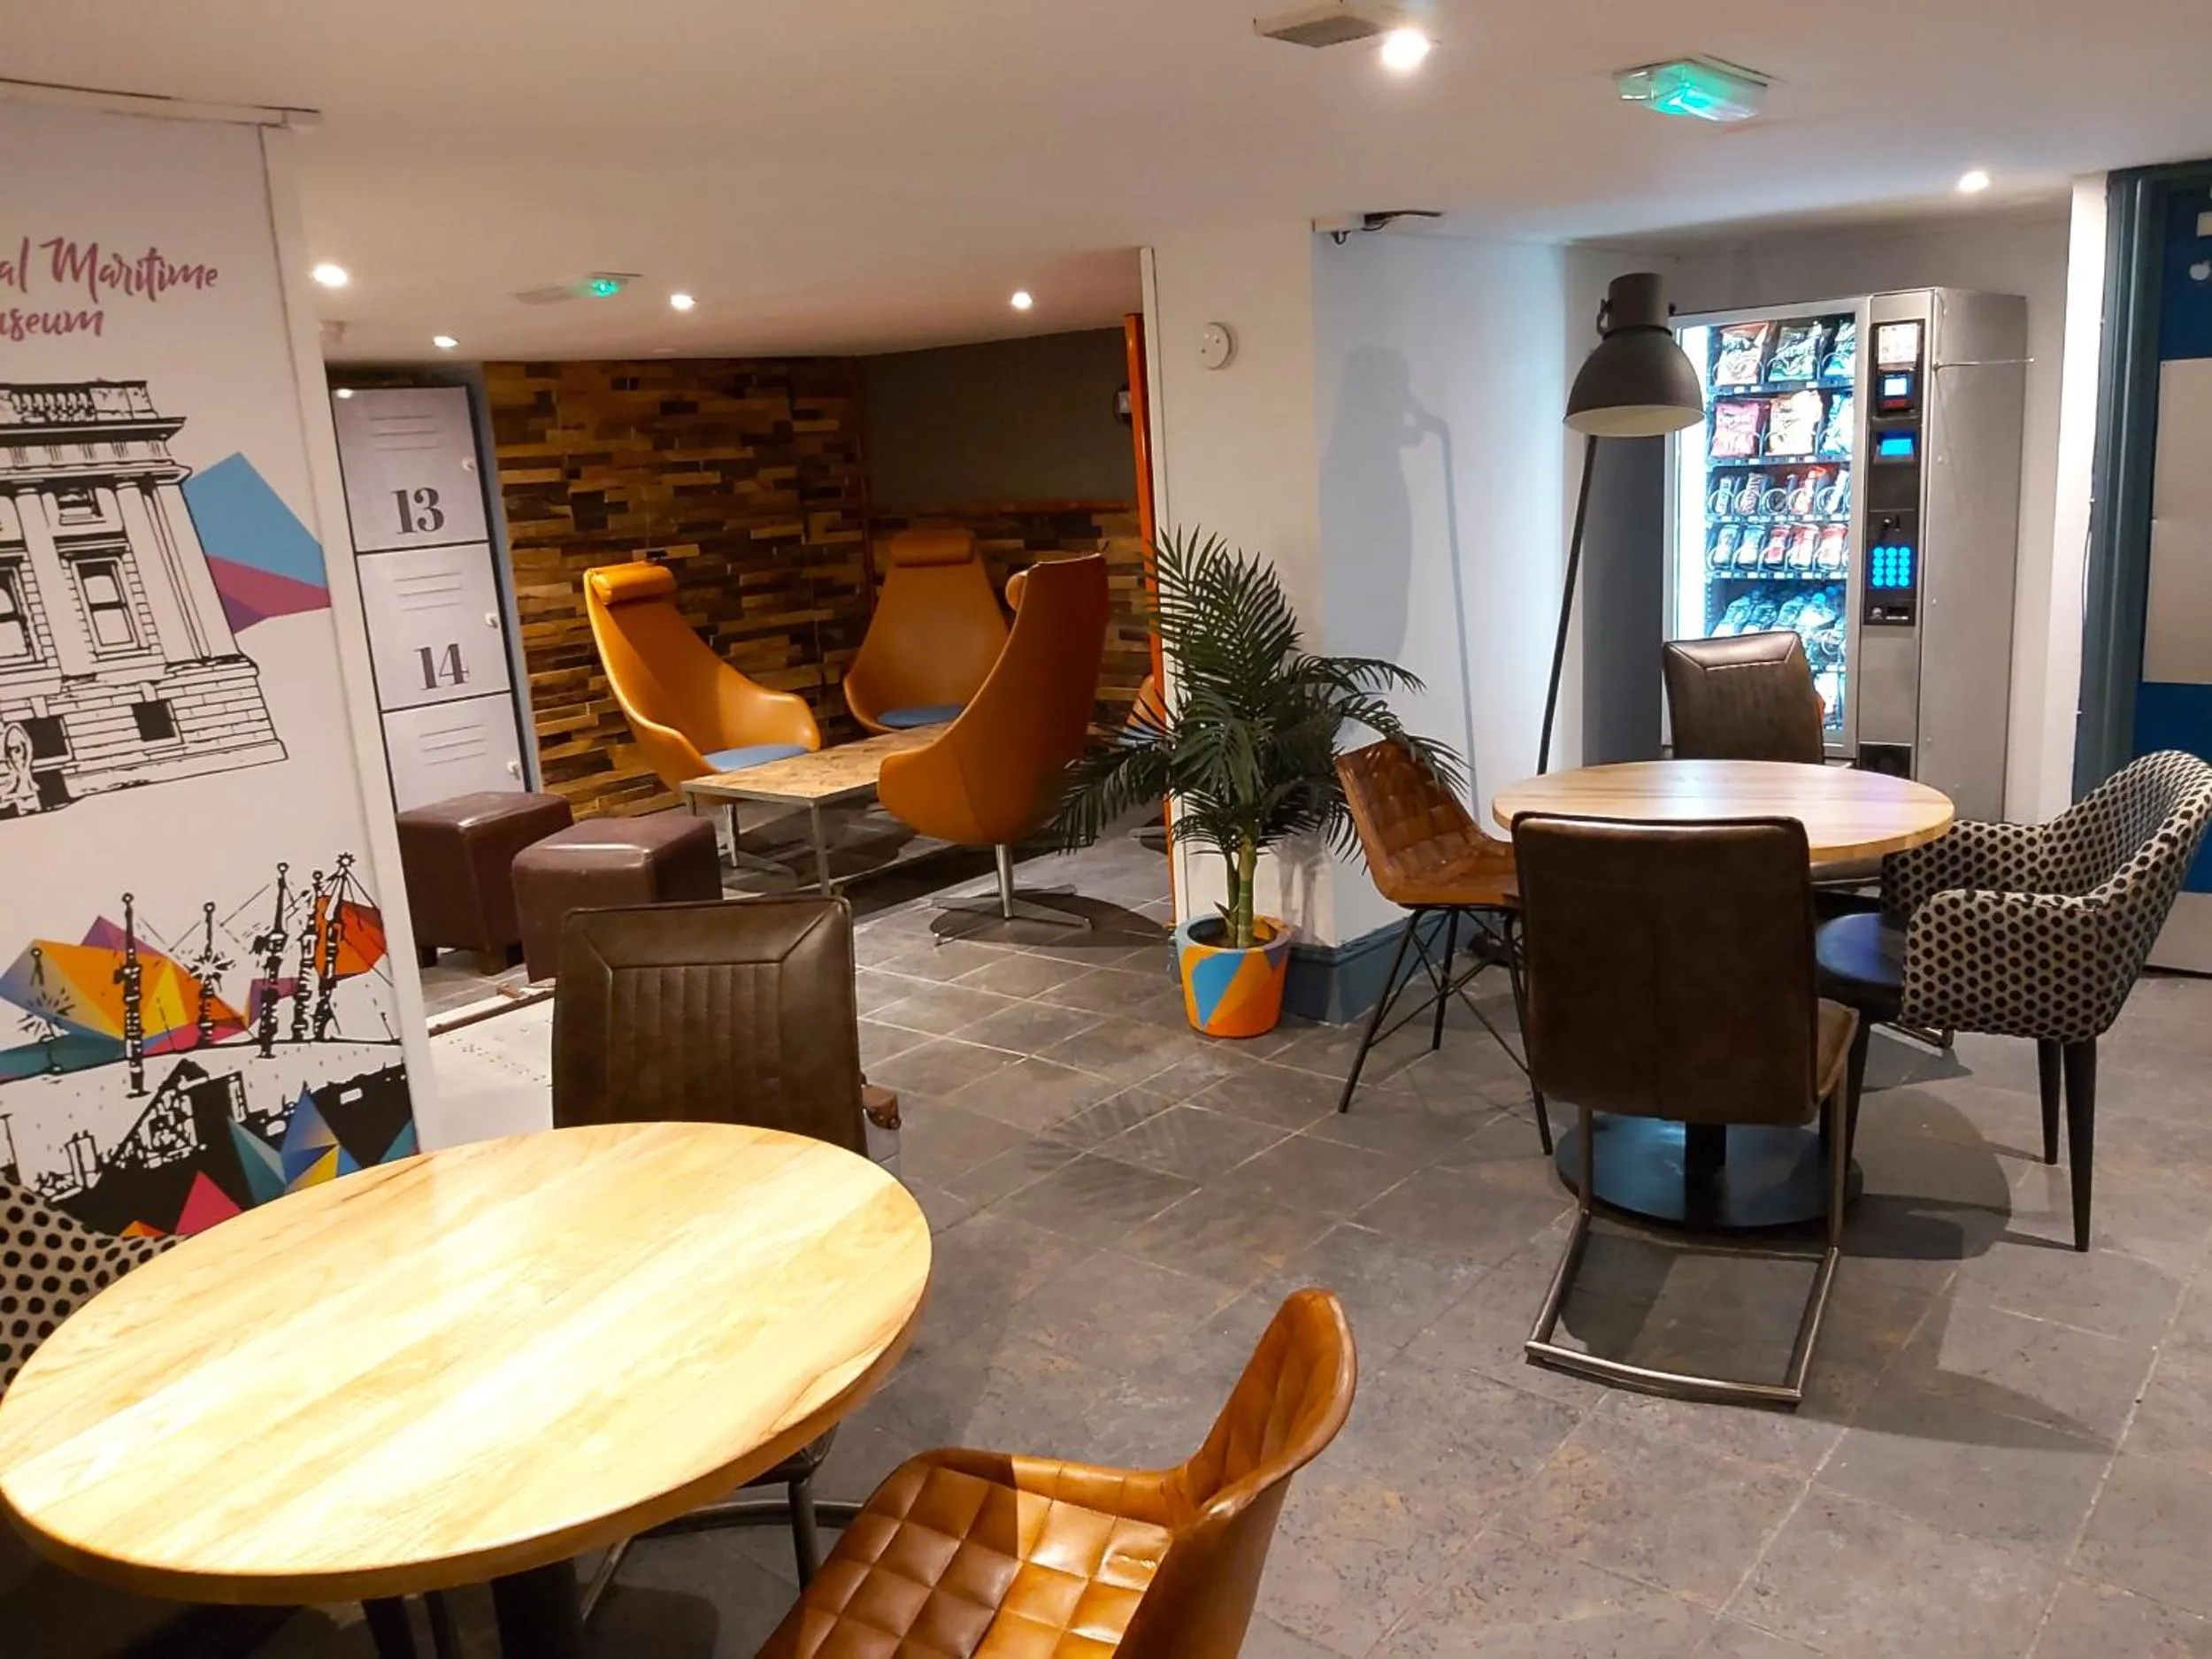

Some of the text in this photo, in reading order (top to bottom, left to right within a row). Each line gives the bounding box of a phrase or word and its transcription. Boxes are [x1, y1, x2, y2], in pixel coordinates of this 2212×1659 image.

[39, 235, 219, 304] Maritime
[391, 487, 444, 534] 13
[413, 642, 469, 691] 14
